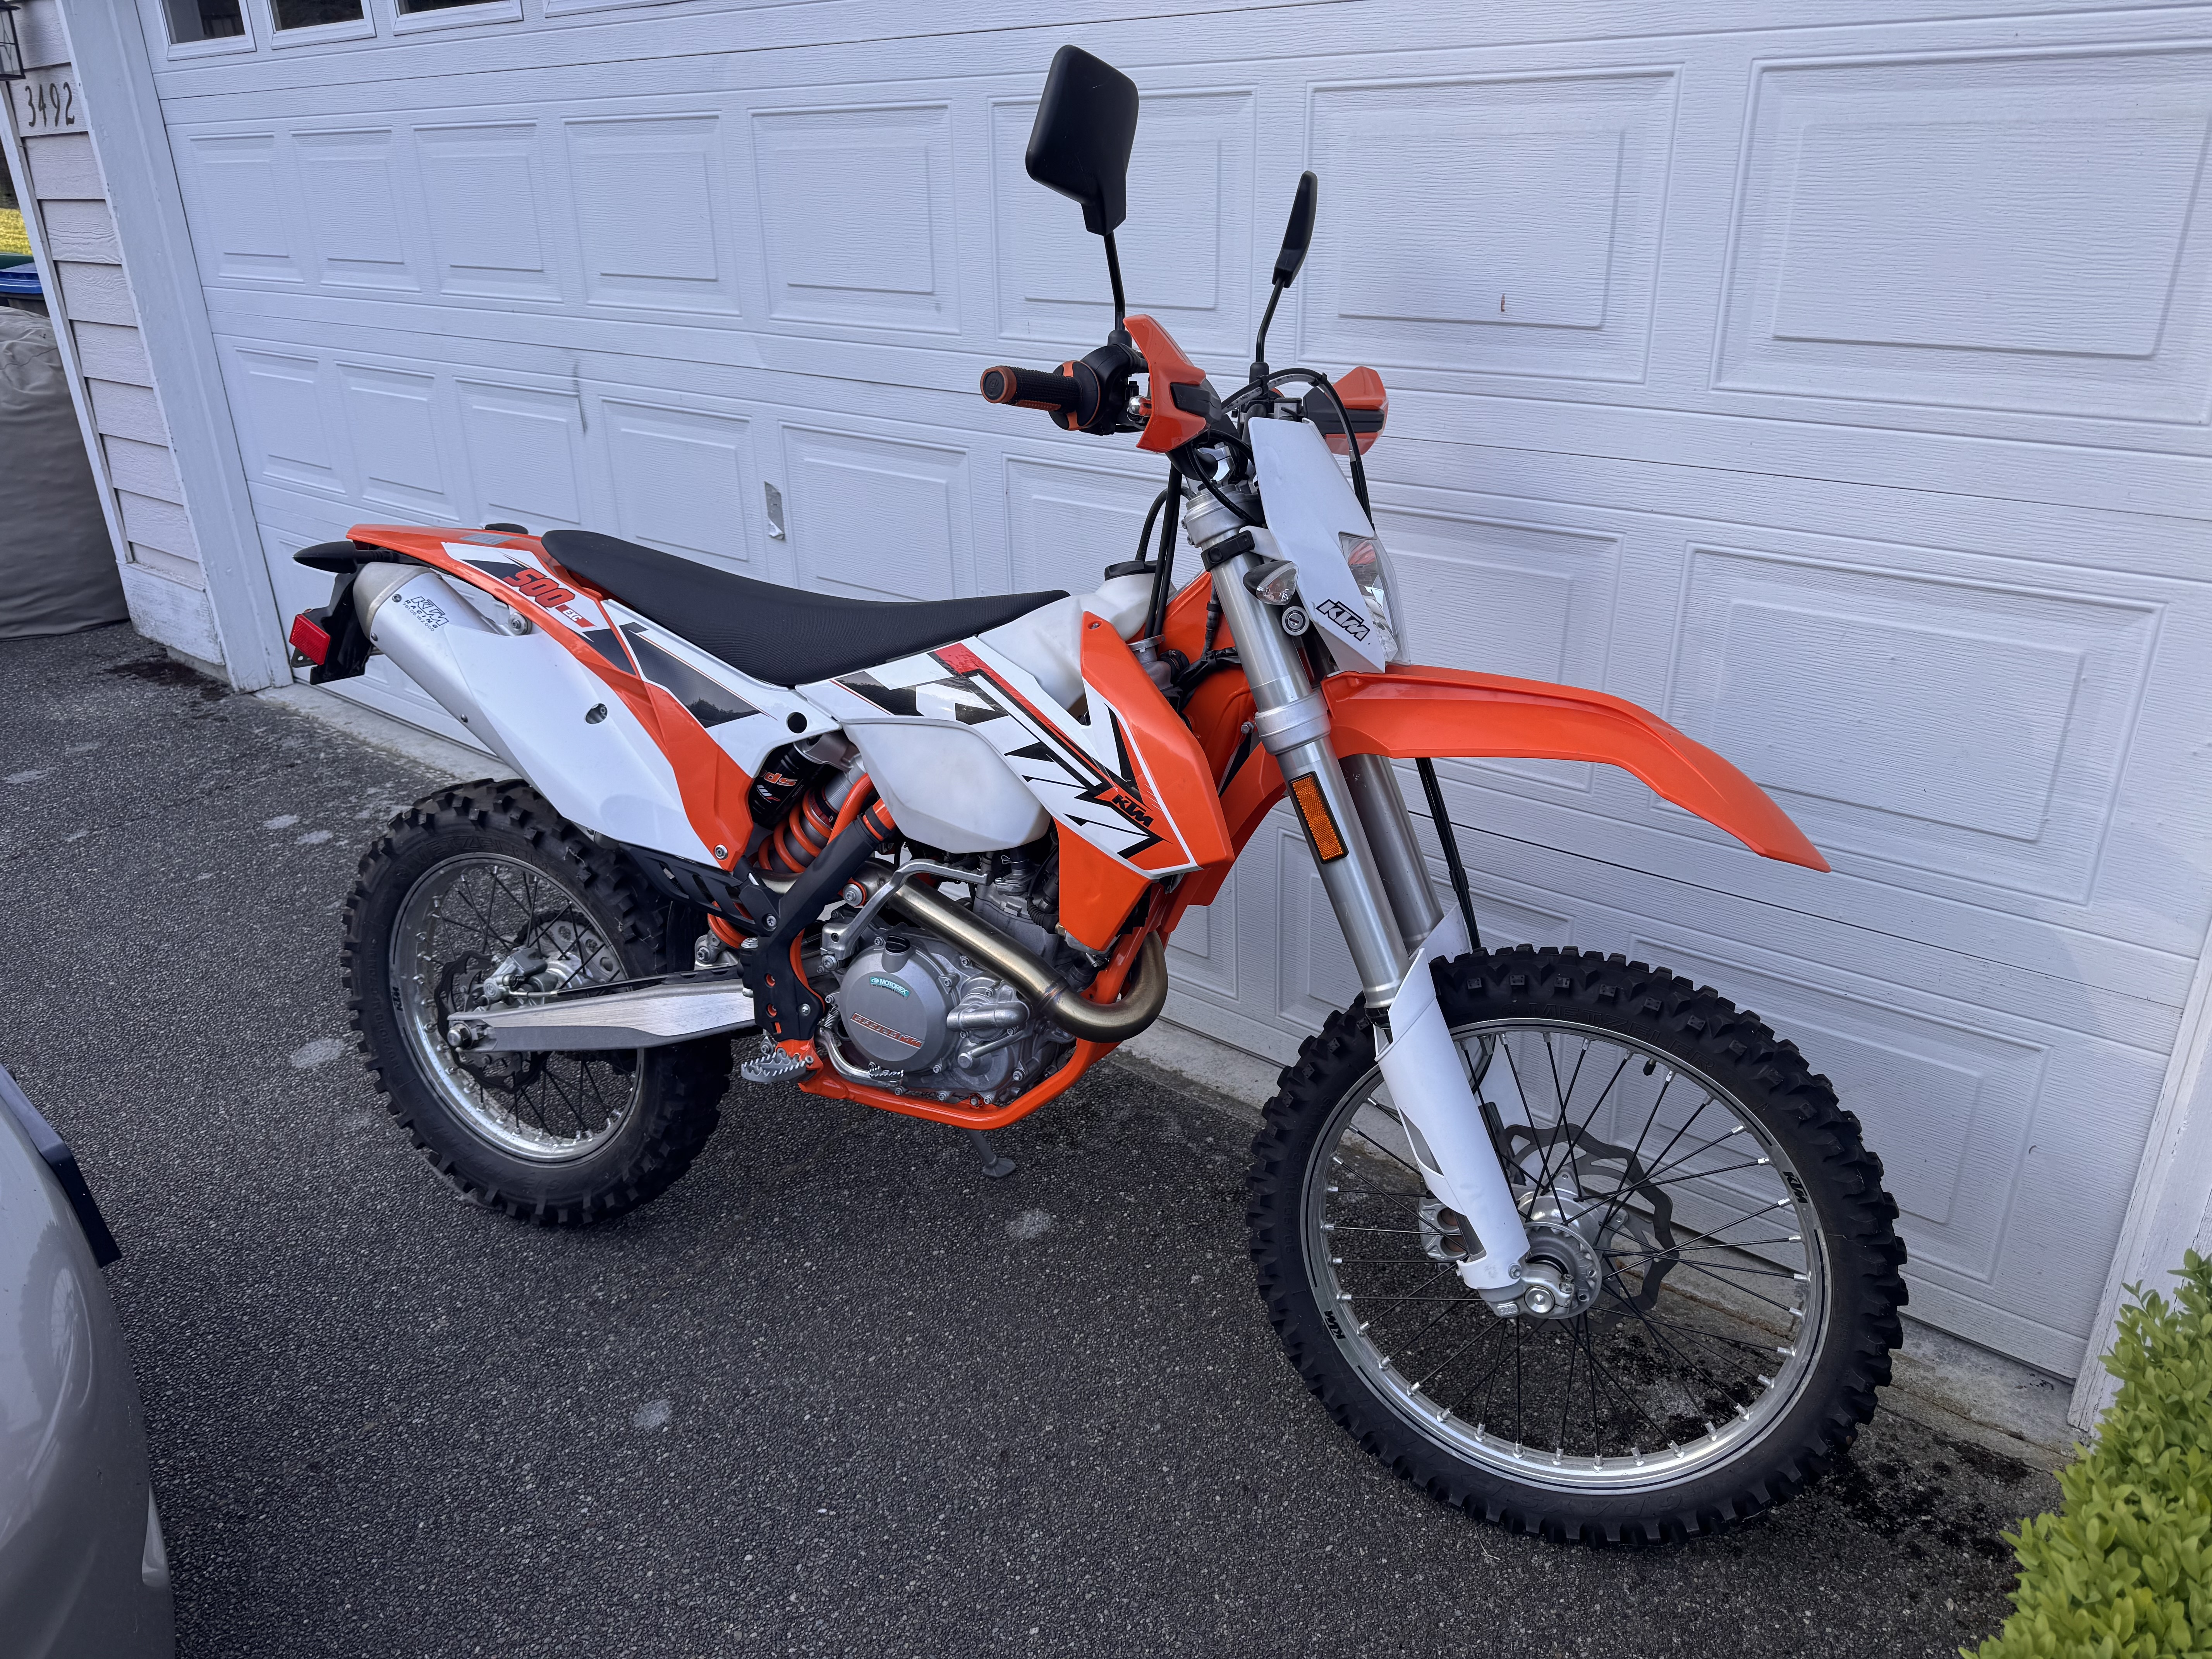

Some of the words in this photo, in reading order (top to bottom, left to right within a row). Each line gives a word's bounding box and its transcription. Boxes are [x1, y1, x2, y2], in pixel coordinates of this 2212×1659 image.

[25, 82, 75, 127] 3492
[502, 567, 576, 608] 500
[405, 600, 438, 628] RACING
[410, 596, 449, 626] KTM
[562, 609, 582, 622] EXC
[1316, 599, 1370, 642] KTM
[1111, 794, 1154, 828] KTM
[879, 978, 908, 995] MOTOREX
[1782, 1171, 1808, 1204] KTM
[1324, 1310, 1346, 1340] KTM
